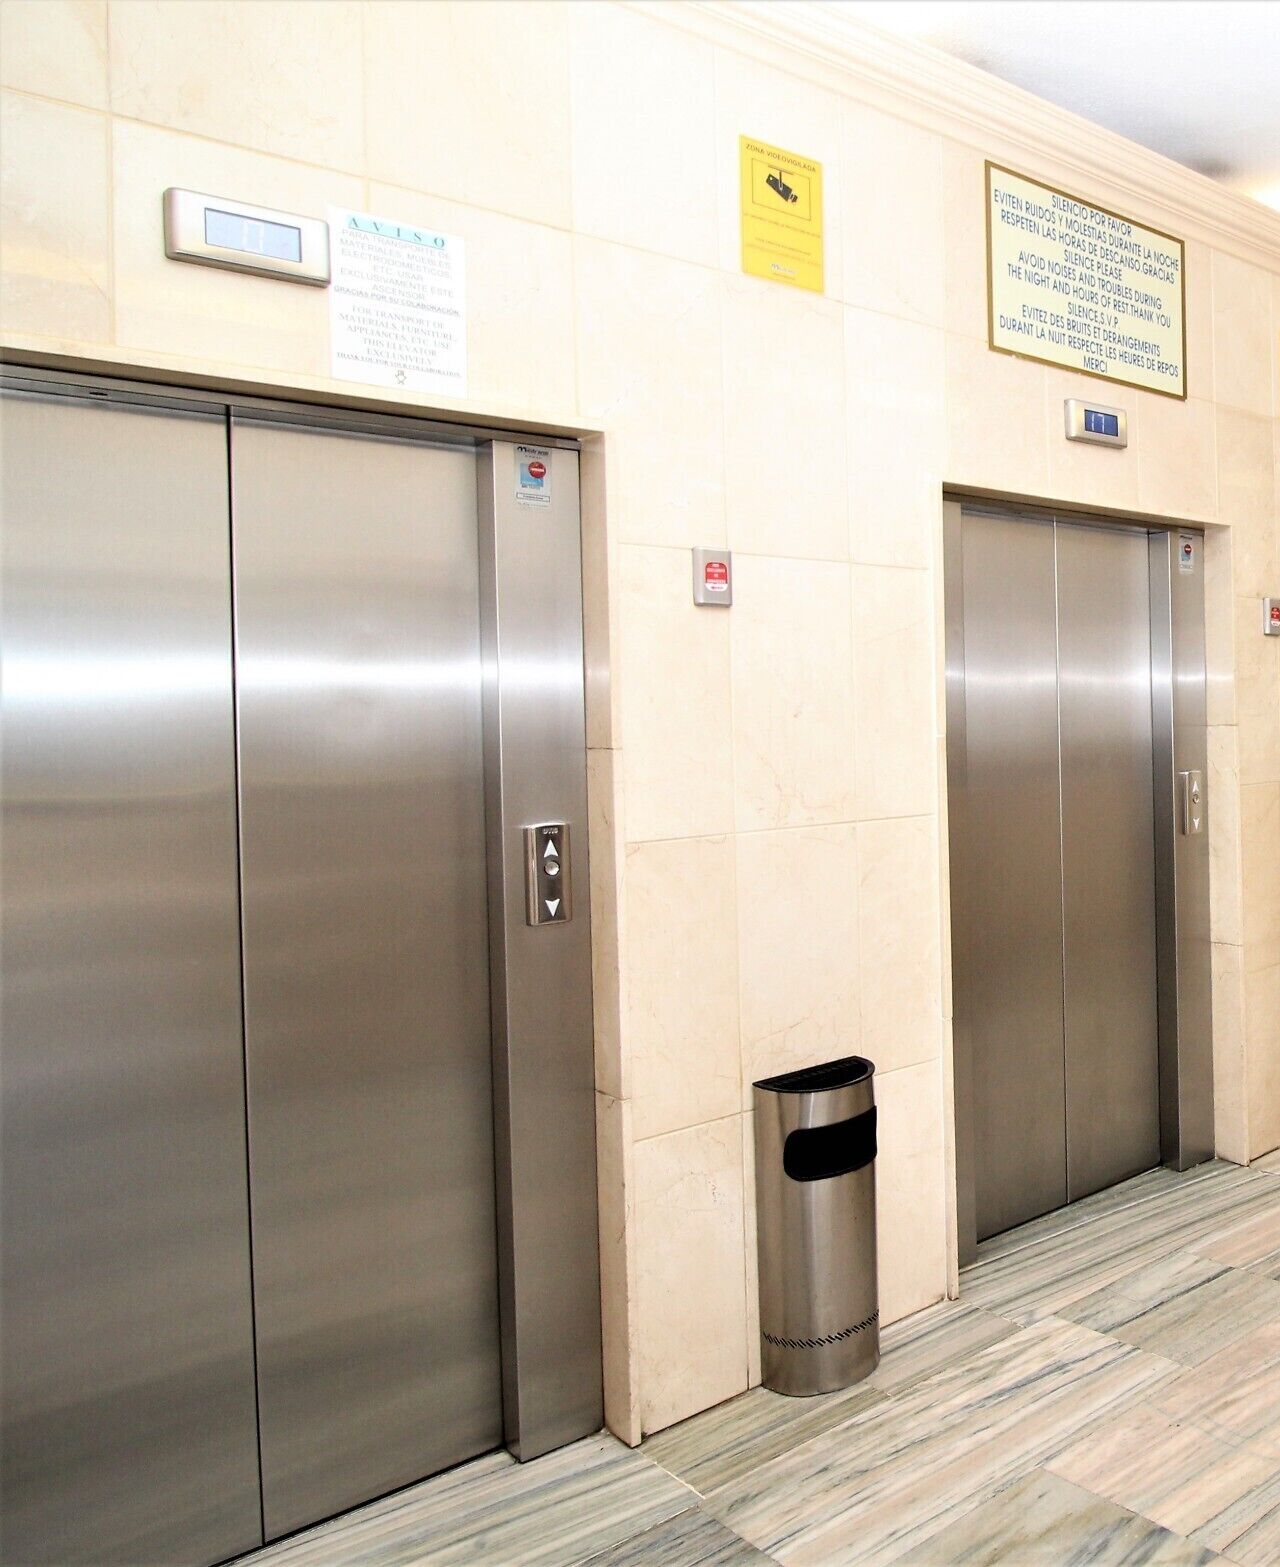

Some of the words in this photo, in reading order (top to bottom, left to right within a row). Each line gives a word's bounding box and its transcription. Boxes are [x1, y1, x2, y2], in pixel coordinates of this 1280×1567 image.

[745, 143, 765, 154] ZONA
[767, 151, 816, 172] VIDEOVIGILADA
[994, 188, 1022, 212] EVITEN
[1025, 200, 1055, 225] RUIDOS
[1058, 213, 1062, 227] Y
[1065, 216, 1106, 244] MOLESTIAS
[1108, 232, 1141, 257] DURANTE
[1143, 246, 1150, 261] LA
[1153, 250, 1178, 271] NOCHE
[1001, 208, 1039, 235] RESPETEN
[1042, 224, 1056, 241] LAS
[1058, 230, 1085, 252] HORAS
[1088, 241, 1097, 256] DE
[1052, 195, 1088, 221] SILENCIO
[1090, 210, 1105, 227] POR
[1107, 216, 1132, 237] FAVOR
[341, 228, 368, 241] PARA
[372, 235, 434, 256] TRANSPORTE
[349, 217, 446, 249] AVISO
[397, 269, 423, 281] USAR
[1018, 250, 1044, 271] AVOID
[1048, 260, 1075, 282] NOISES
[1078, 270, 1095, 288] AND
[1097, 276, 1132, 300] TROUBLES
[1134, 289, 1161, 310] DURING
[1064, 248, 1094, 271] SILENCE
[1096, 260, 1121, 281] PLEASE
[334, 285, 368, 298] GRACIAS
[370, 292, 386, 302] POR
[389, 296, 398, 304] SU
[340, 266, 427, 292] EXCLUSIVAMENTE
[430, 286, 453, 298] ESTE
[1007, 263, 1021, 280] THE
[1024, 268, 1050, 289] NIGHT
[1052, 277, 1070, 296] AND
[1072, 284, 1098, 305] HOURS
[1100, 293, 1110, 309] OF
[1156, 312, 1170, 329] YOU
[352, 305, 371, 315] FOR
[375, 309, 429, 326] TRANSPORT
[1022, 304, 1047, 324] EVITEZ
[1050, 312, 1064, 329] DES
[1066, 317, 1090, 337] BRUITS
[1093, 325, 1100, 340] ET
[1103, 328, 1159, 357] DERANGEMENTS
[336, 351, 358, 361] THANK
[363, 336, 383, 347] THIS
[386, 341, 436, 356] ELEVATOR
[366, 347, 432, 366] EXCLUSIVELY
[1000, 315, 1033, 337] DURANT
[1036, 325, 1044, 340] LA
[1048, 329, 1065, 346] NUIT
[1068, 334, 1103, 356] RESPECTE
[1105, 345, 1116, 360] LES
[1119, 349, 1144, 368] HEURES
[1146, 356, 1155, 371] DE
[1157, 360, 1178, 377] REPOS
[1083, 355, 1107, 374] MERCI
